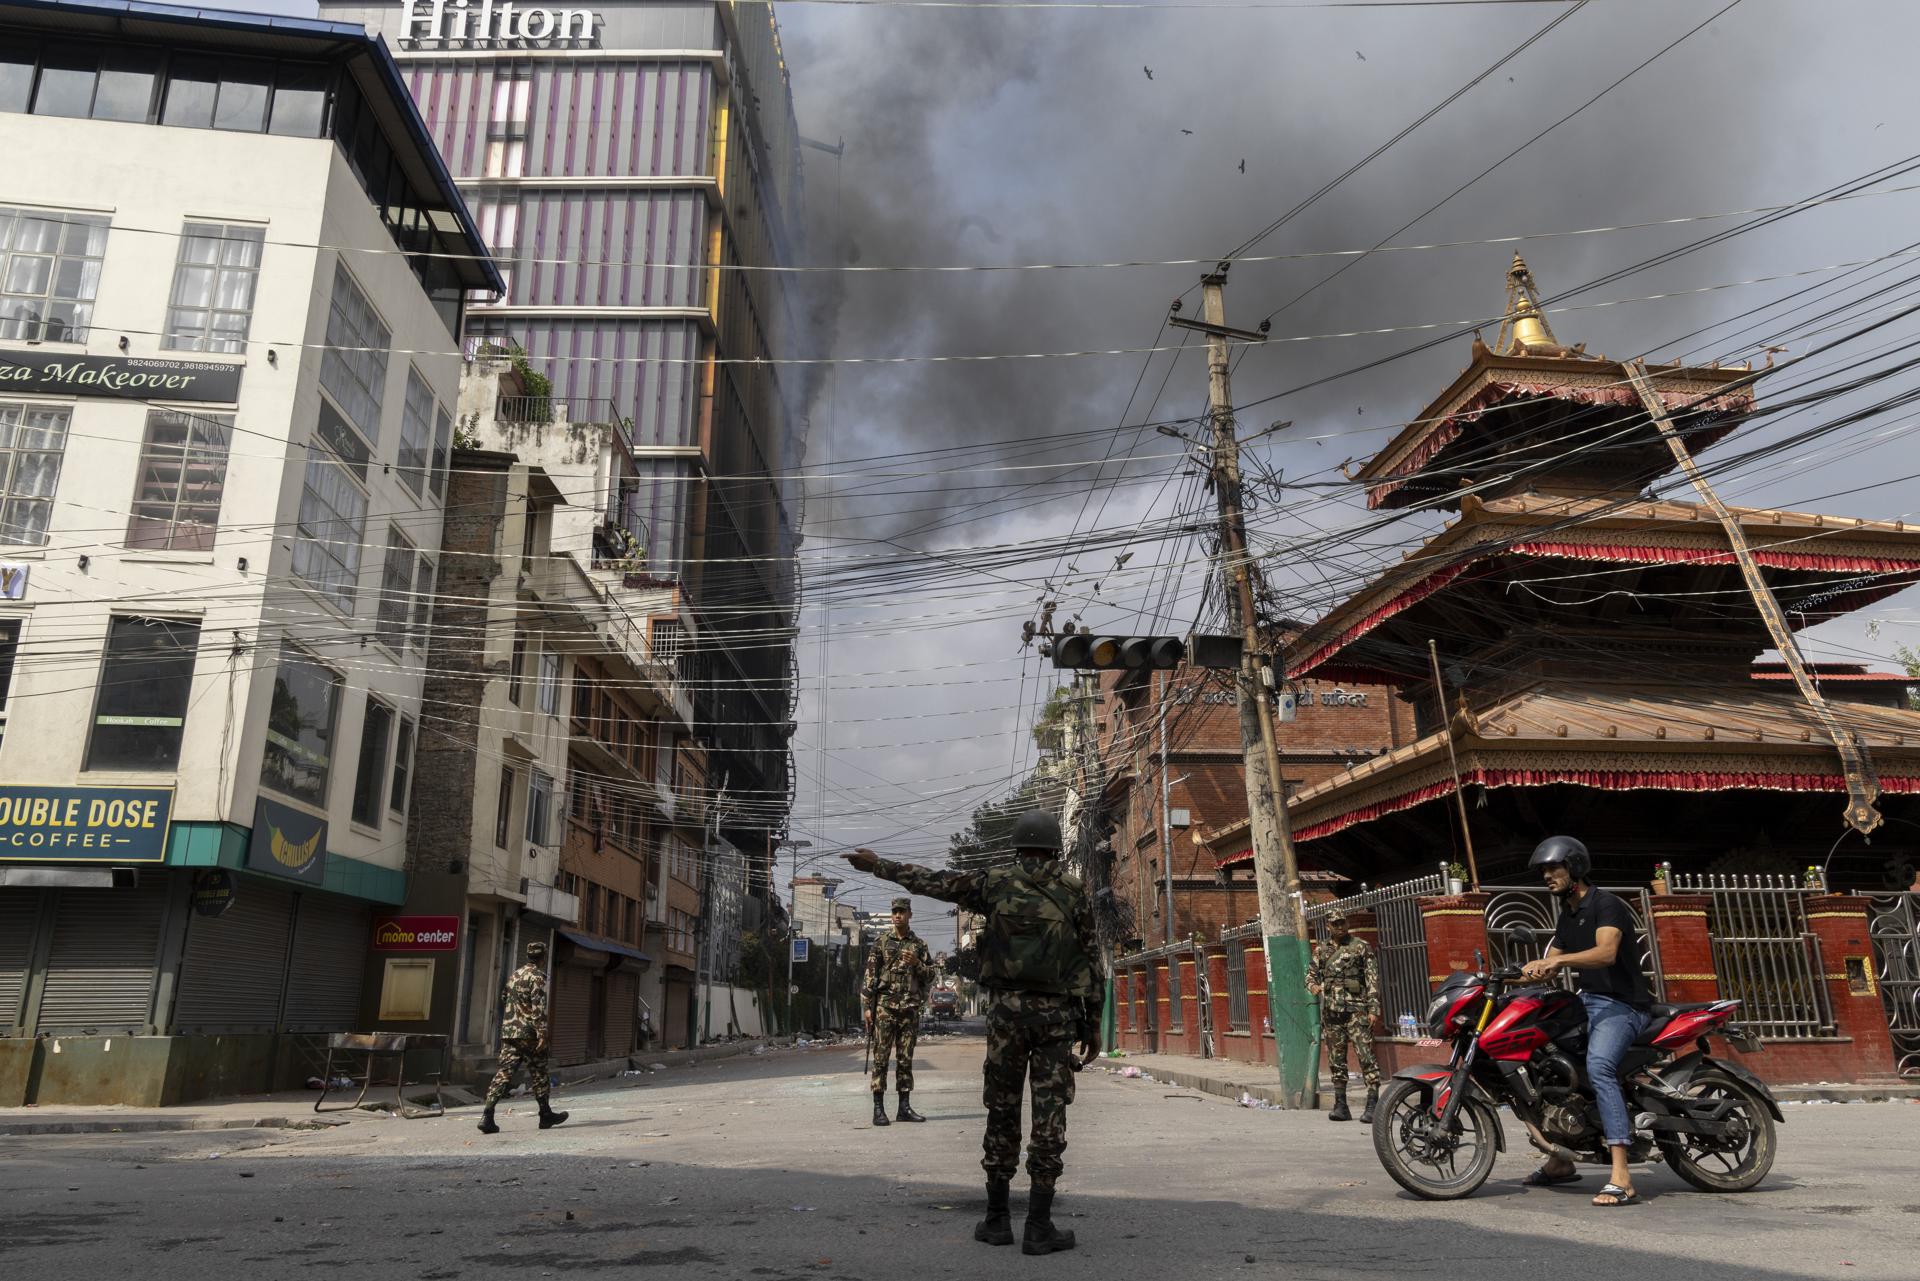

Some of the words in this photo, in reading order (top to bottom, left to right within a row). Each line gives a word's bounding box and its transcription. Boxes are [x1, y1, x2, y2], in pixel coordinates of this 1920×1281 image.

[397, 0, 595, 40] Hilton
[127, 358, 180, 370] 9824069702
[40, 362, 196, 390] Makeover
[1, 567, 18, 592] Y
[144, 717, 169, 726] Coffee
[0, 797, 82, 827] OUBLE
[87, 799, 160, 829] DOSE
[11, 832, 112, 848] COFFEE
[382, 932, 415, 944] momo
[417, 929, 455, 943] center
